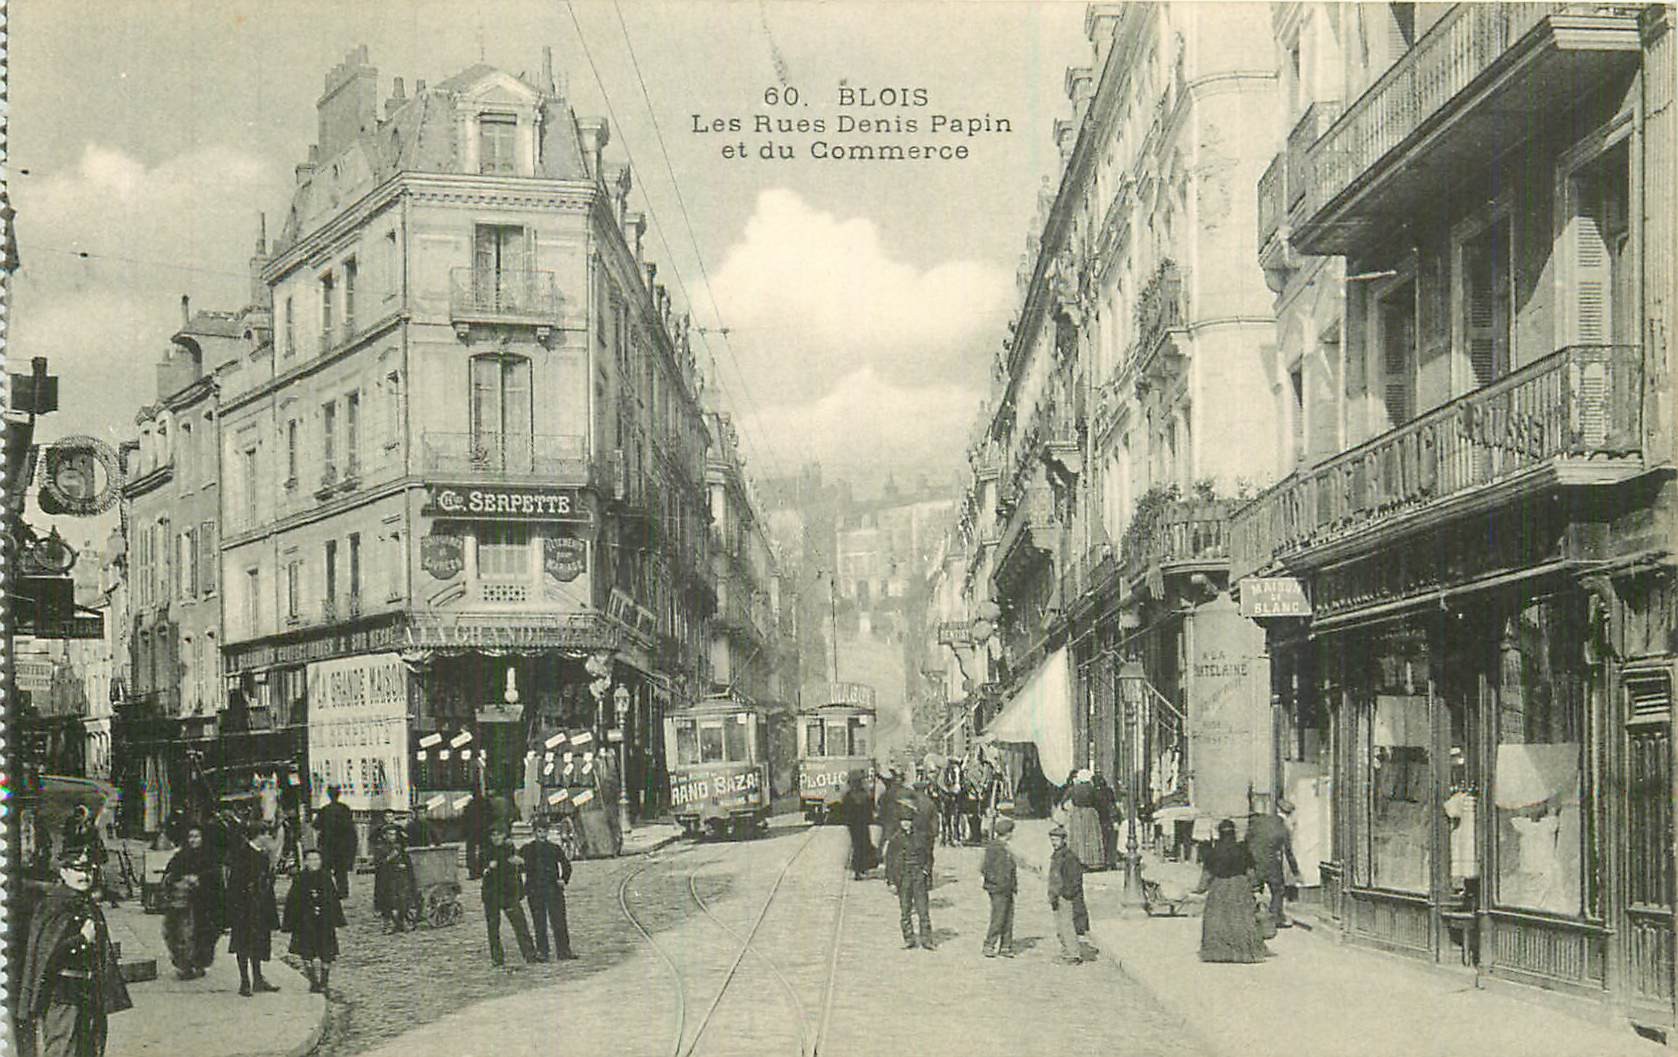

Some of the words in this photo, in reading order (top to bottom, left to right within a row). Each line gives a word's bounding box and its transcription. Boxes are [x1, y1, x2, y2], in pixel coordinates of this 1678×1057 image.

[469, 490, 571, 513] SERPETTE
[1254, 601, 1300, 613] BLANC
[330, 668, 366, 707] GRANDE
[368, 663, 405, 705] MAISON
